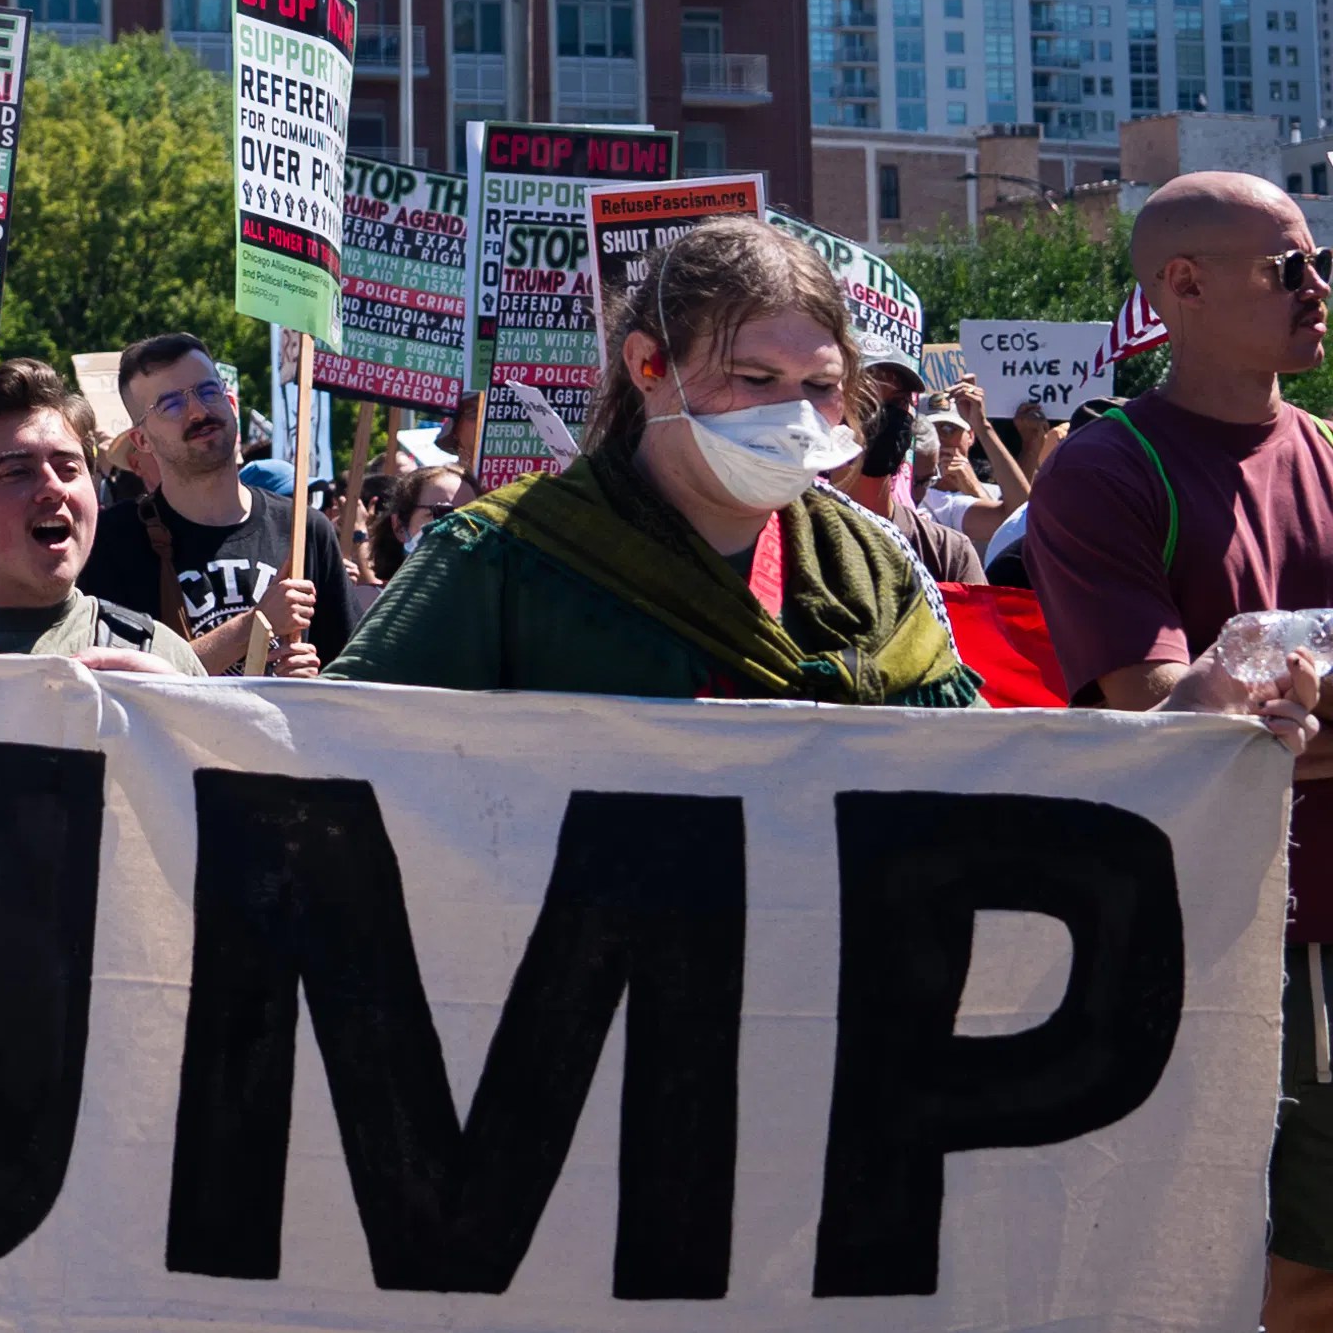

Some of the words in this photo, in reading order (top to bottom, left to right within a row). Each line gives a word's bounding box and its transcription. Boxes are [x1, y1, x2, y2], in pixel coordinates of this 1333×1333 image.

[240, 24, 335, 85] SUPPORT
[241, 107, 266, 133] FOR
[241, 136, 301, 187] OVER
[489, 133, 573, 169] CPOP
[588, 138, 667, 174] NOW!
[601, 191, 747, 215] RefuseFascism.org
[242, 219, 265, 242] ALL
[268, 226, 303, 254] POWER
[394, 228, 405, 241] &
[602, 228, 649, 254] SHUT
[421, 247, 462, 266] RIGH
[505, 227, 587, 270] STOP
[366, 253, 399, 270] WITH
[348, 263, 364, 276] US
[370, 268, 393, 282] AID
[401, 274, 418, 287] TO
[503, 268, 566, 294] TRUMP
[863, 254, 915, 307] THE
[356, 281, 409, 303] POLICE
[366, 301, 436, 325] LGBTQIA+
[500, 295, 562, 313] DEFEND
[573, 298, 583, 314] &
[498, 311, 590, 329] IMMIGRANT
[859, 305, 922, 345] EXPAND
[405, 341, 447, 358] RIGHTS
[498, 331, 538, 346] STAND
[544, 332, 577, 347] WITH
[385, 351, 393, 364] &
[404, 355, 464, 377] STRIKE
[496, 347, 520, 361] END
[526, 348, 543, 362] US
[549, 349, 573, 363] AID
[357, 361, 442, 389] EDUCATION
[449, 380, 459, 393] &
[493, 366, 528, 381] STOP
[535, 367, 588, 384] POLICE
[1002, 359, 1061, 376] HAVE
[382, 382, 458, 407] FREEDOM
[1028, 383, 1073, 405] SAY
[486, 424, 525, 438] DEFEND
[482, 459, 534, 474] DEFEND
